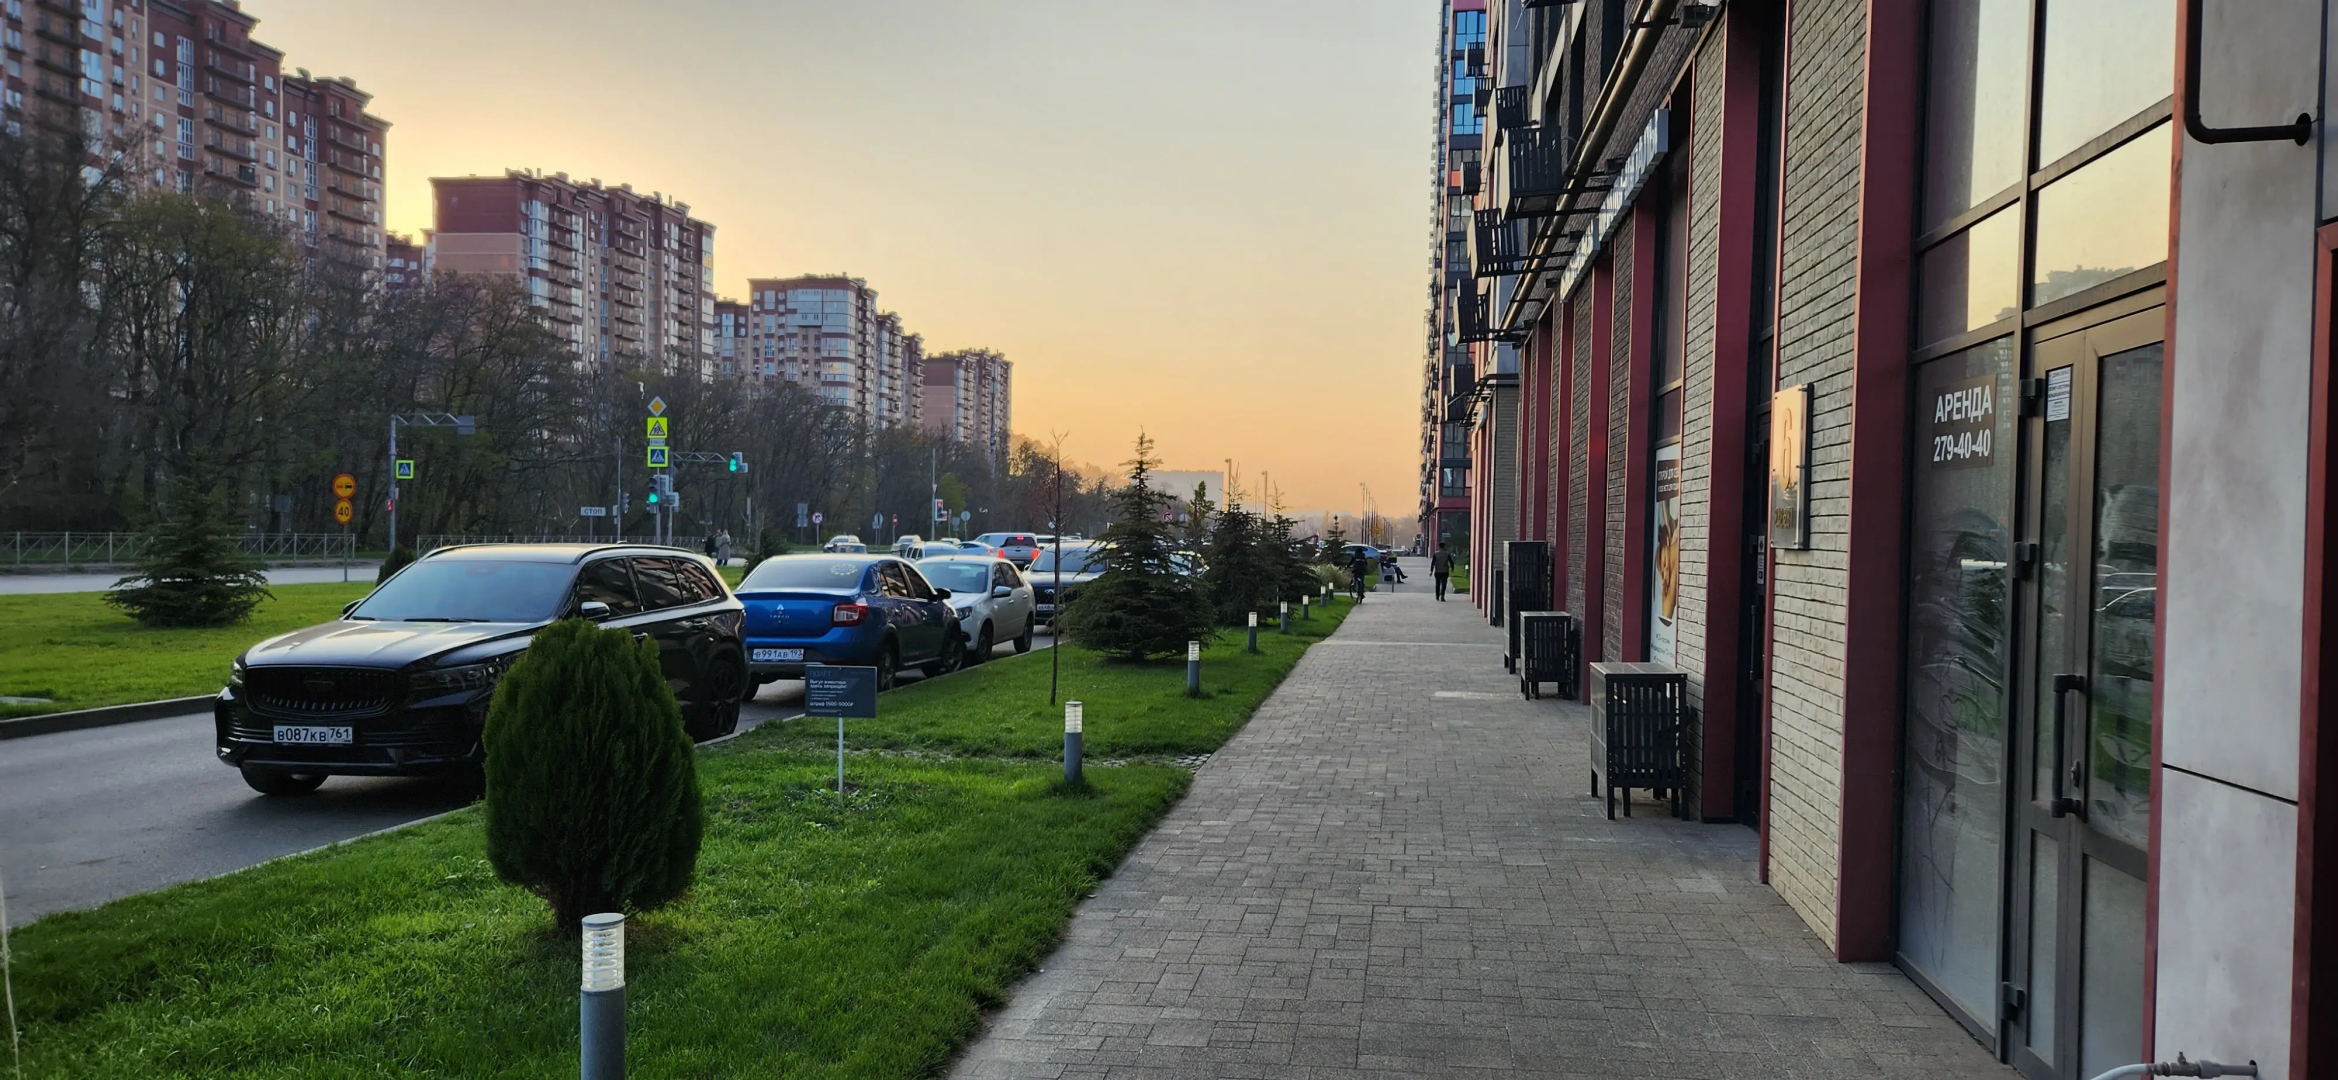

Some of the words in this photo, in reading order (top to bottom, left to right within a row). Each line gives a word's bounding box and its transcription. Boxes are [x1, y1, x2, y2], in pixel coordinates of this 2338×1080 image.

[1934, 385, 1992, 423] АРЕНДА
[1933, 428, 1991, 462] 279-40-40
[338, 506, 350, 517] 40
